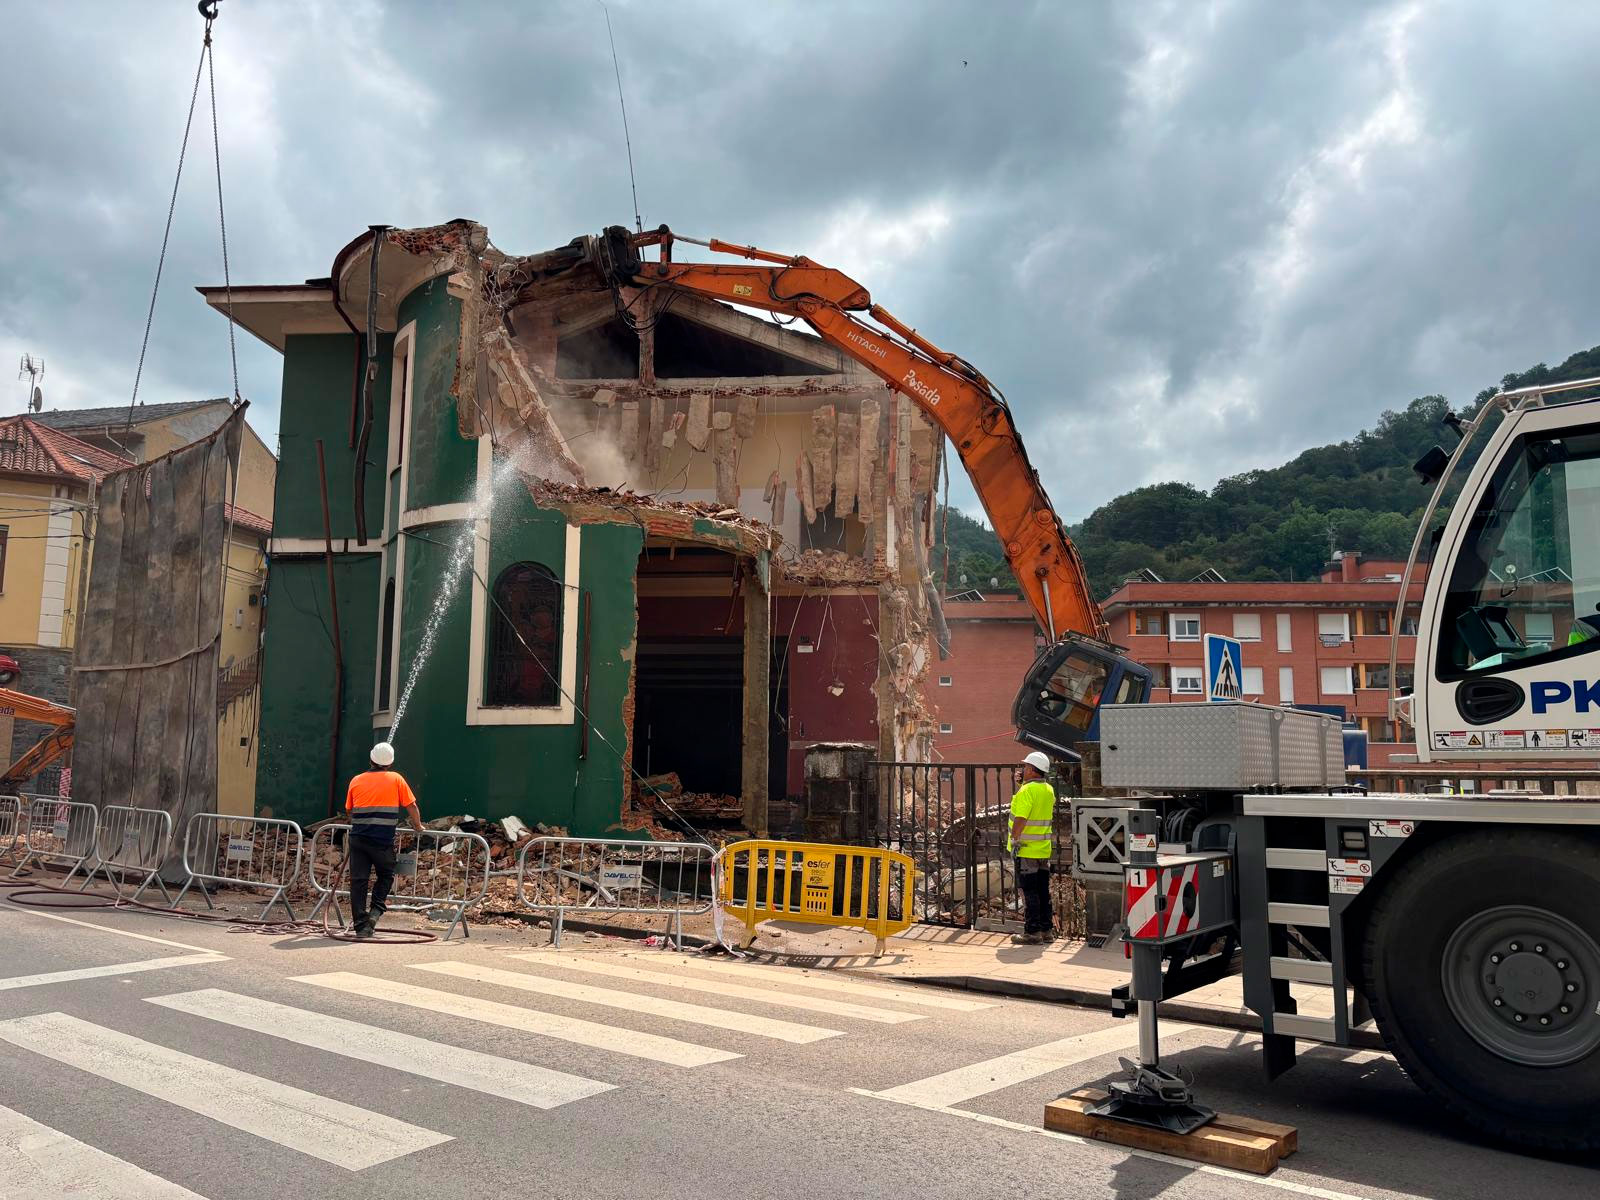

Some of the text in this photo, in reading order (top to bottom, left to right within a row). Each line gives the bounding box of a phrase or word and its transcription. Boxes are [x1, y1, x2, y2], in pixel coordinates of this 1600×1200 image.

[847, 331, 887, 358] HITACHI
[902, 369, 940, 406] Posada
[1530, 680, 1600, 714] PK
[807, 860, 830, 869] esfer
[1134, 870, 1141, 885] 1
